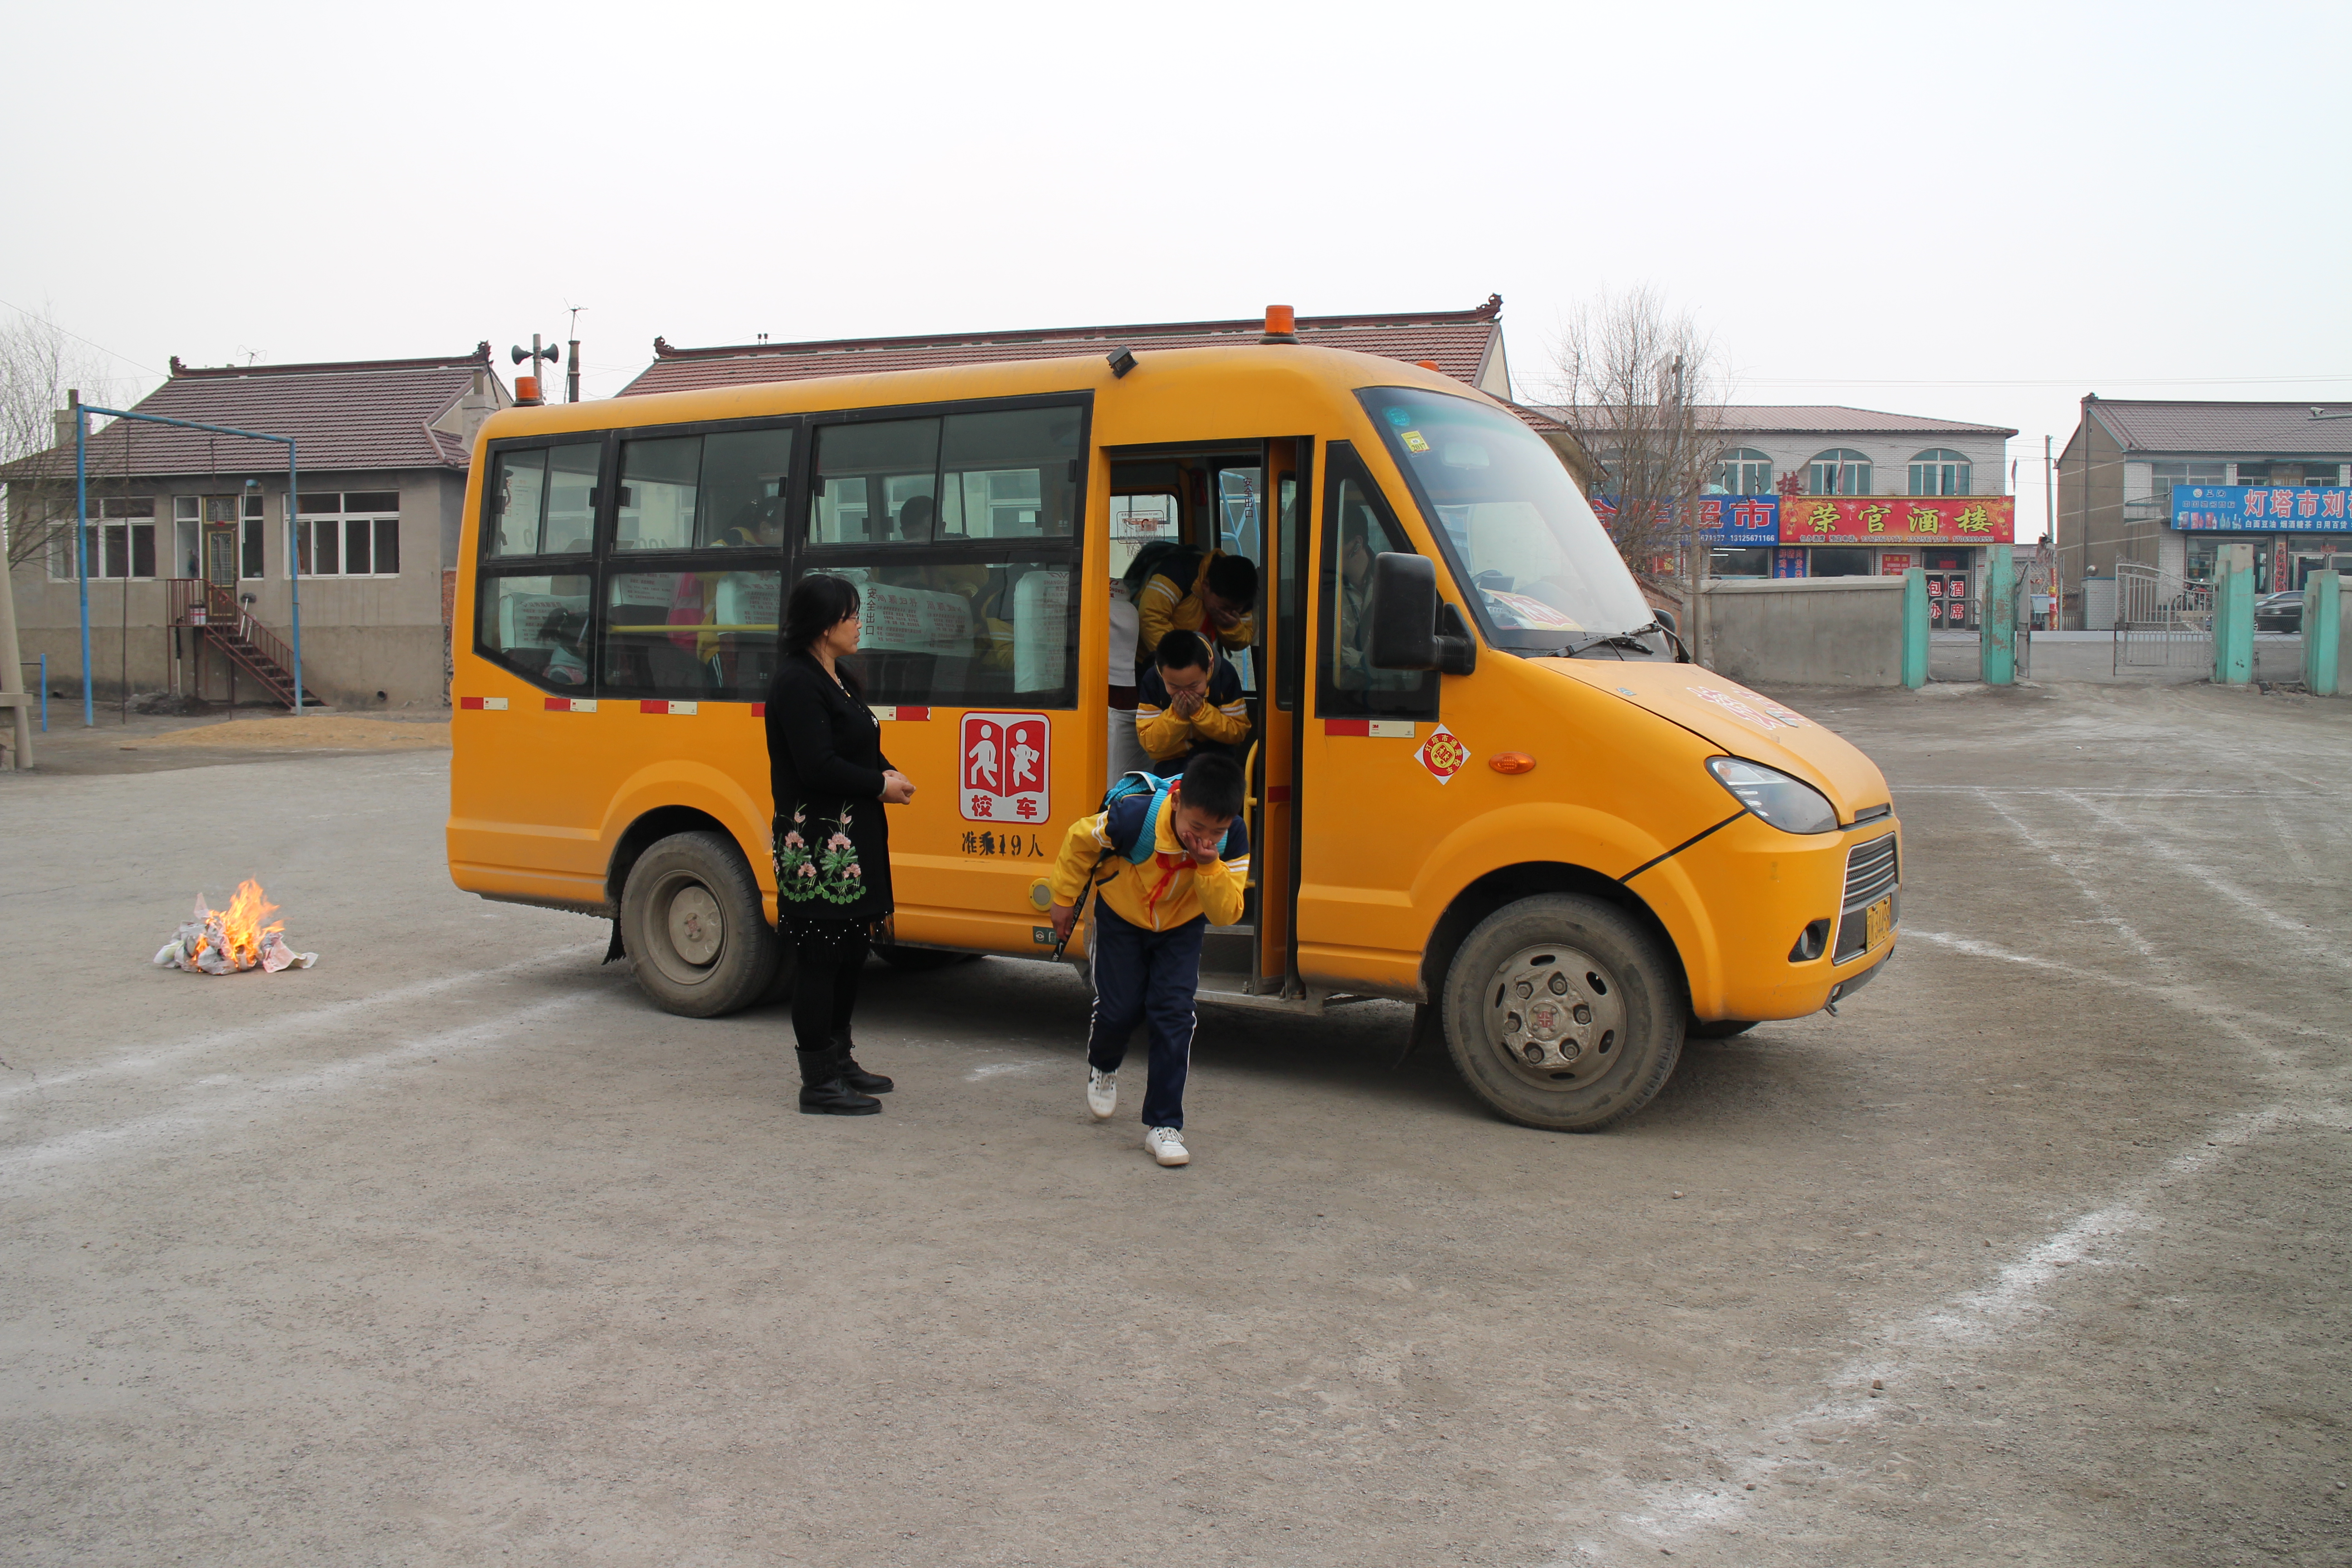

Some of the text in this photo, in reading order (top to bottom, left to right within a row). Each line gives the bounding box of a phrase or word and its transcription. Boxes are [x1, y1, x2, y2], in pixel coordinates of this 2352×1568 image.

[1411, 443, 1426, 451] 2017
[1243, 477, 1253, 518] 安全出口
[1807, 502, 1994, 534] 荣官酒楼
[2245, 520, 2347, 529] 白面豆油 烟酒糖茶 日用百货
[866, 587, 877, 636] 安全出口
[971, 794, 1038, 819] 校车
[962, 831, 1044, 858] 准乘19人
